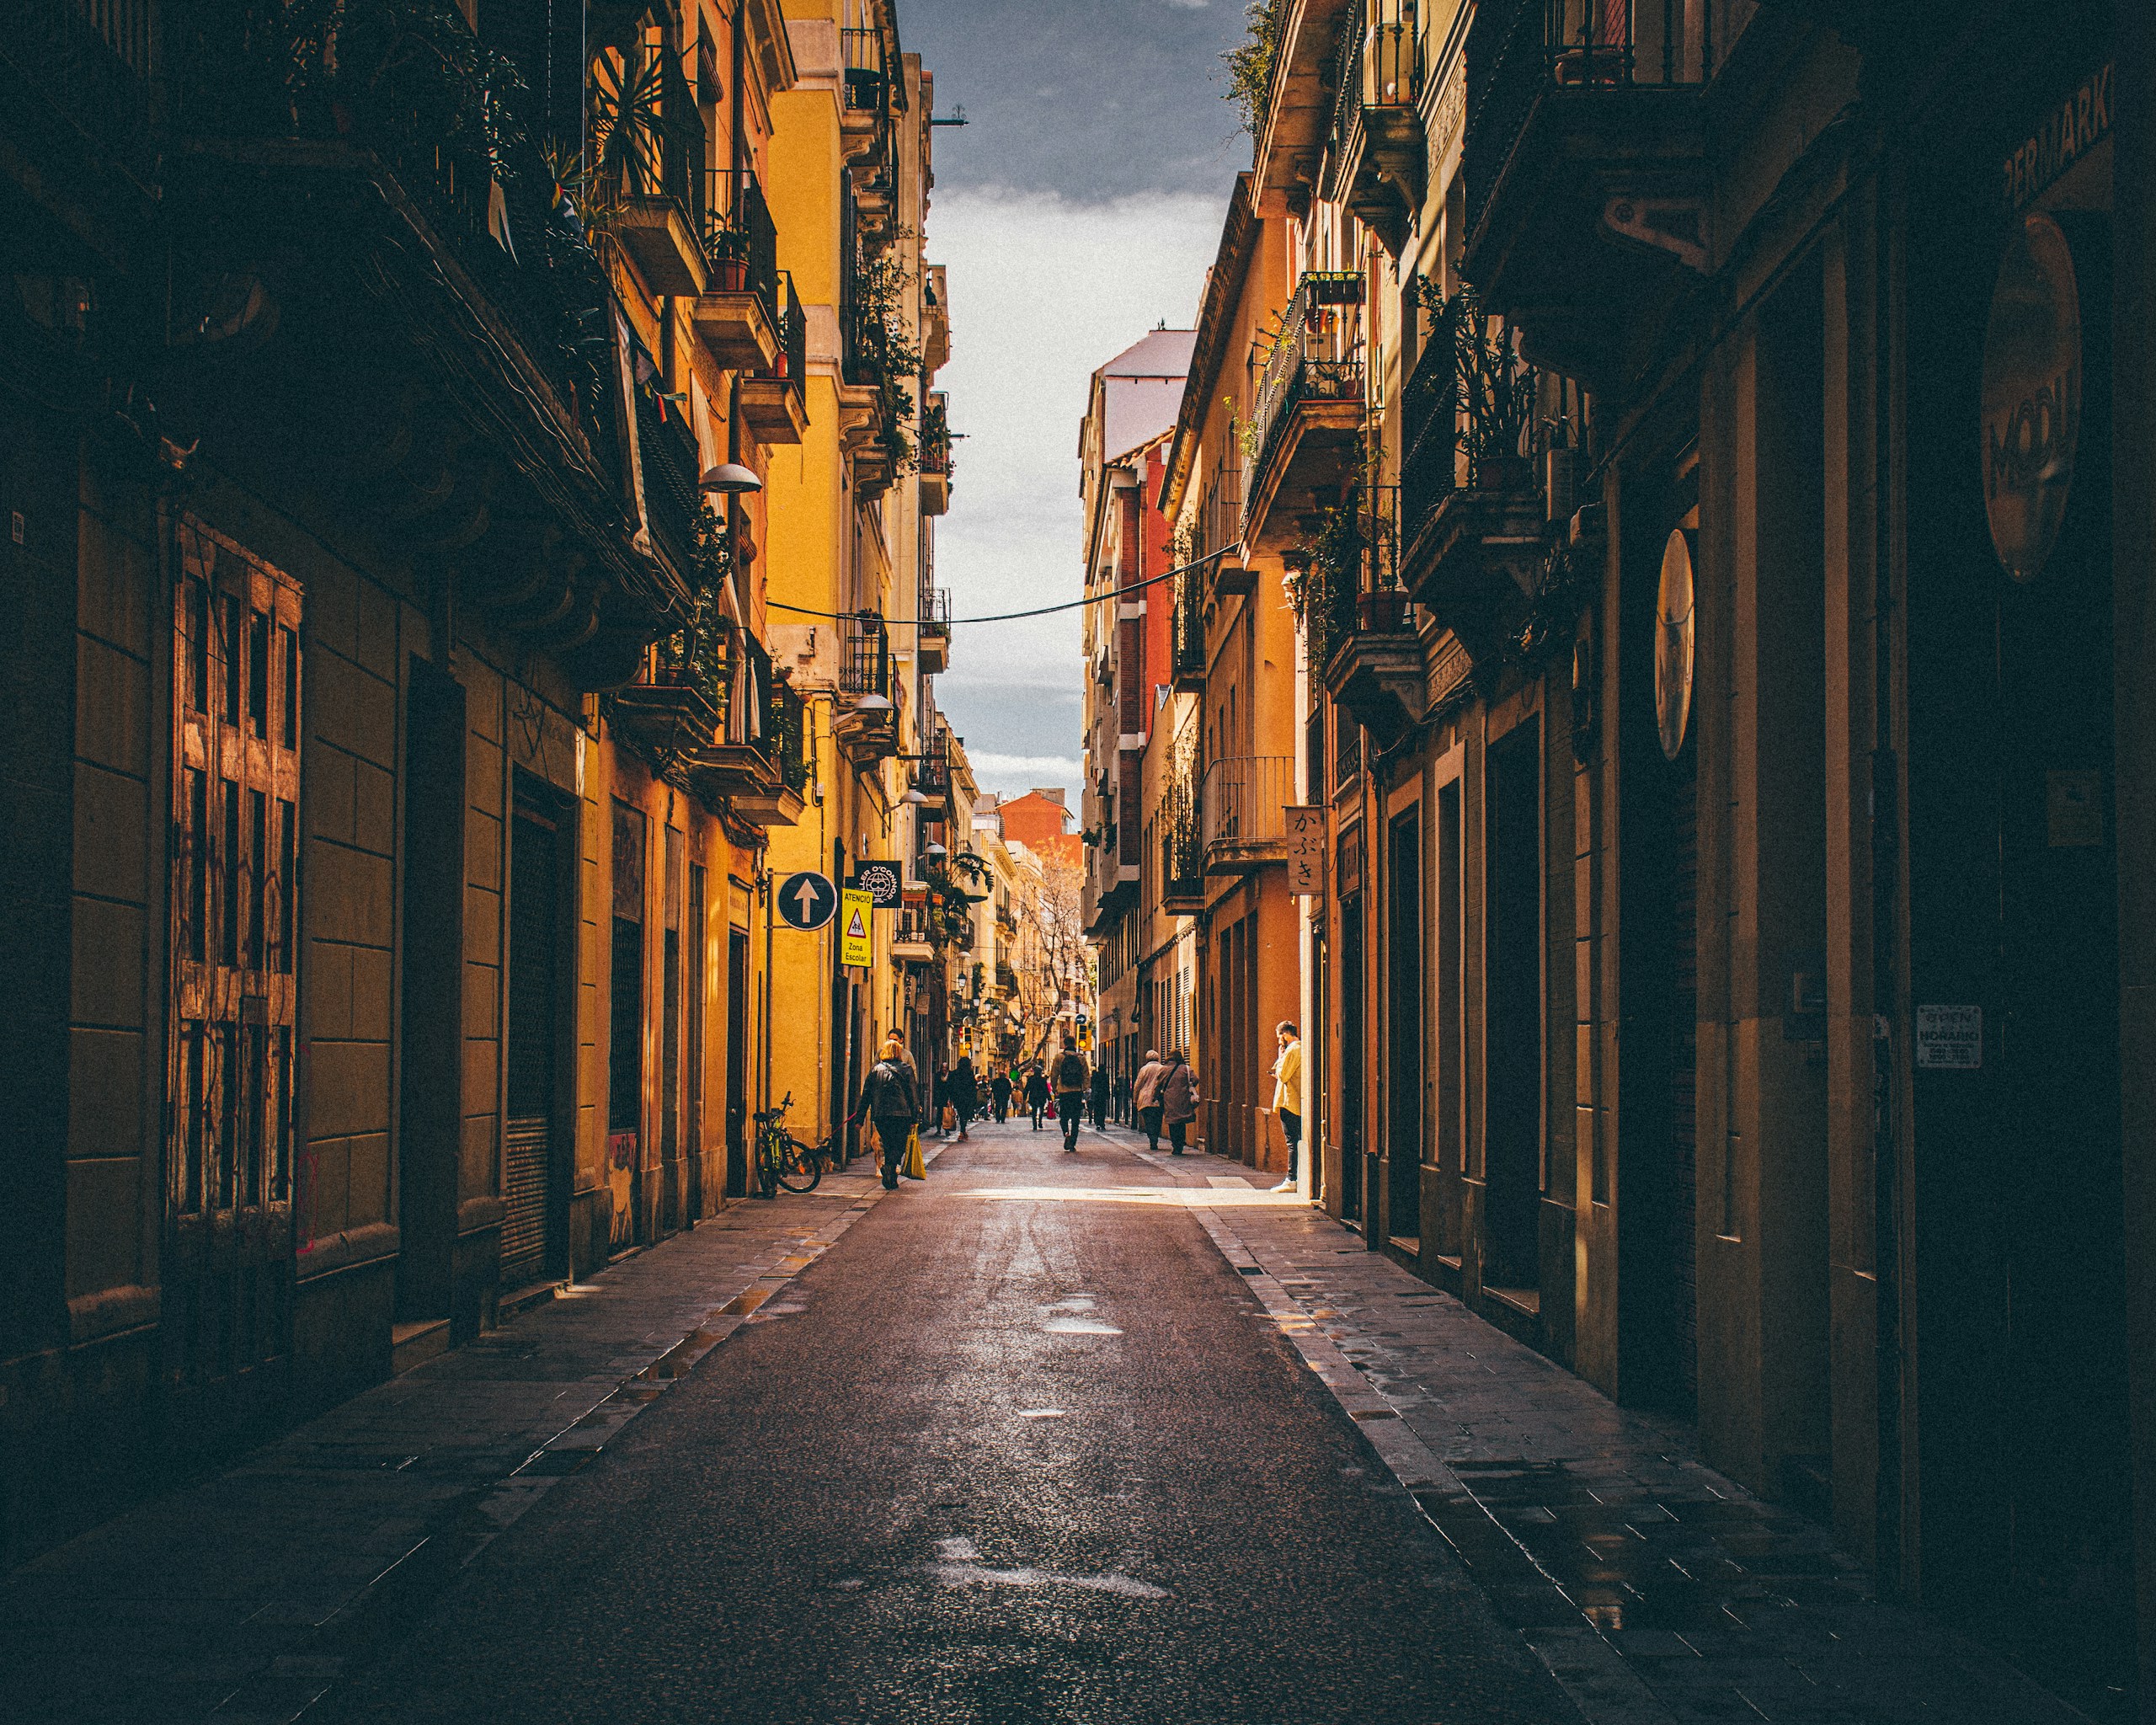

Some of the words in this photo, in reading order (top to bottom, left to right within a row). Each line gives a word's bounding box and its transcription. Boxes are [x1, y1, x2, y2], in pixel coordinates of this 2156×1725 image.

[1293, 813, 1316, 886] かぶき
[872, 866, 897, 900] O'CONNOR
[845, 893, 871, 904] ATENCIÓ
[849, 943, 863, 951] Zona
[846, 953, 867, 962] Escolar
